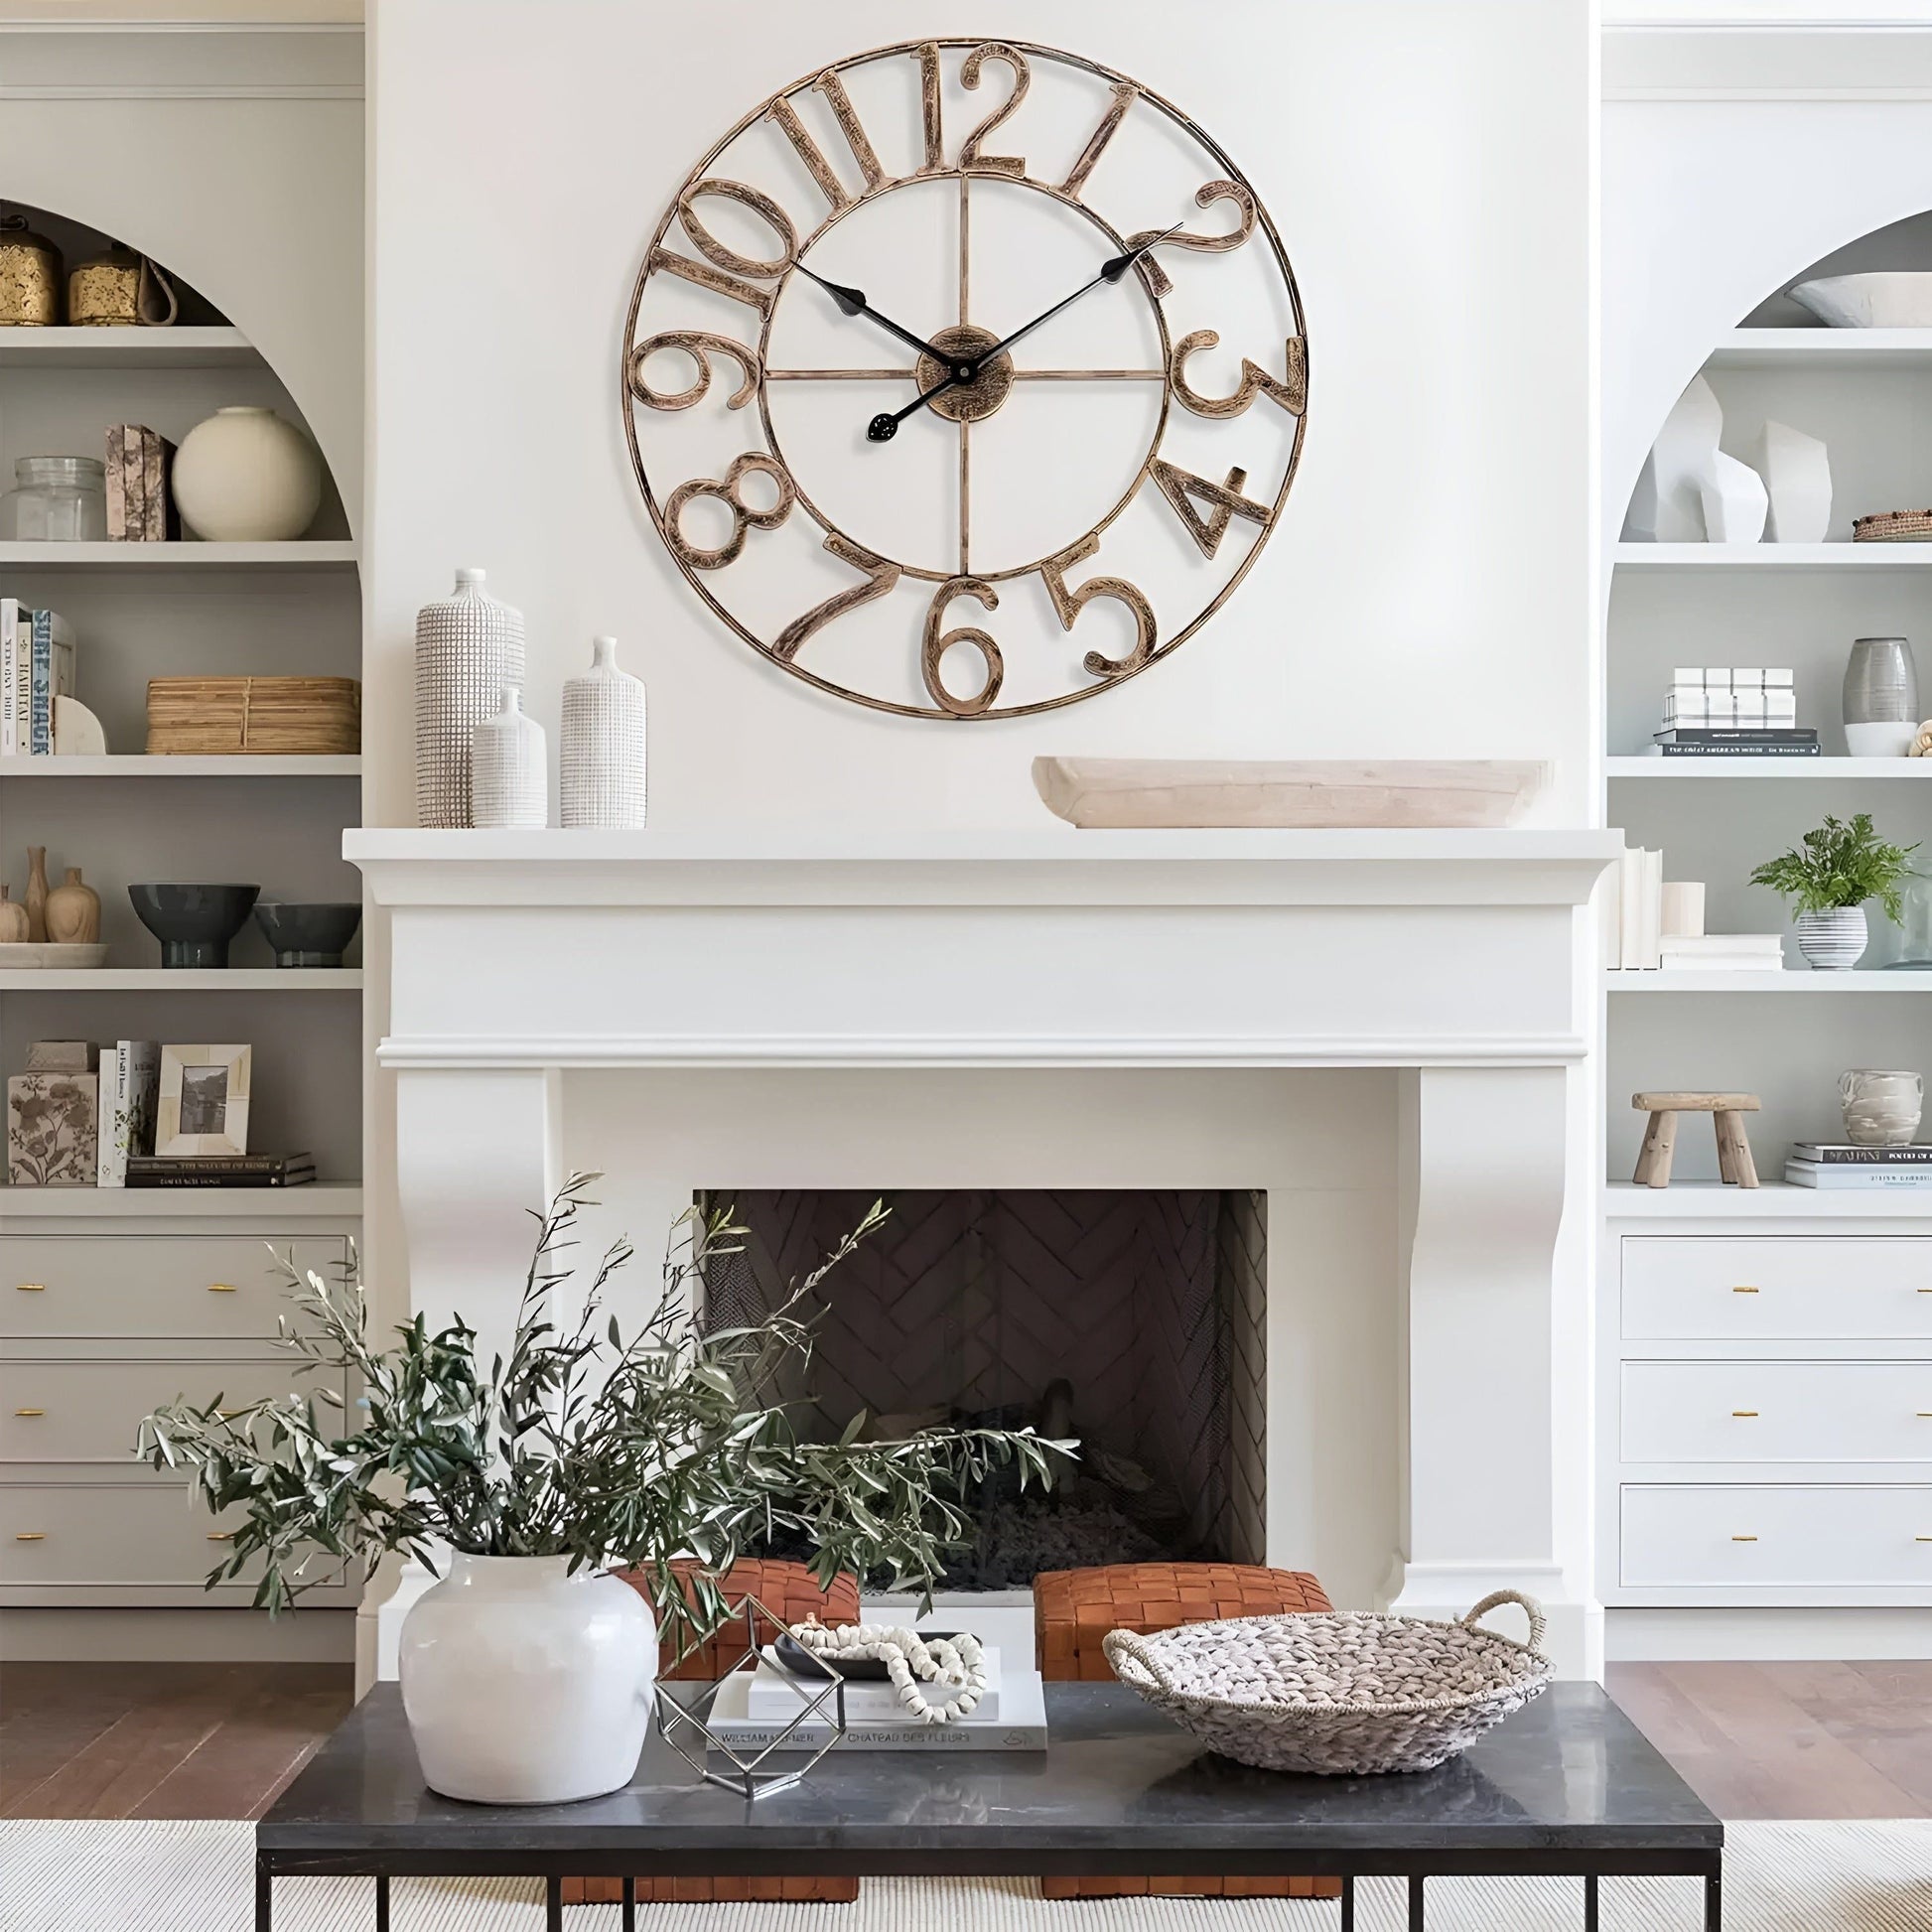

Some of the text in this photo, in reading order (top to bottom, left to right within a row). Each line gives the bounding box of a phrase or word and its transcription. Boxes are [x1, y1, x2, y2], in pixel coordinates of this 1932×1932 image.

[765, 69, 900, 222] 11
[909, 41, 1031, 177] 12
[1048, 82, 1140, 206] 1
[649, 177, 800, 323] 10
[1126, 178, 1259, 298] 2
[629, 330, 761, 411] 9
[1169, 329, 1307, 417] 3
[663, 451, 795, 570] 8
[1148, 457, 1275, 561] 4
[33, 610, 51, 671] SURF
[771, 531, 902, 663] 7
[921, 577, 1004, 716] 6
[1039, 531, 1158, 678] 5
[18, 663, 30, 722] HABITAT
[722, 1732, 768, 1742] WILLIAM
